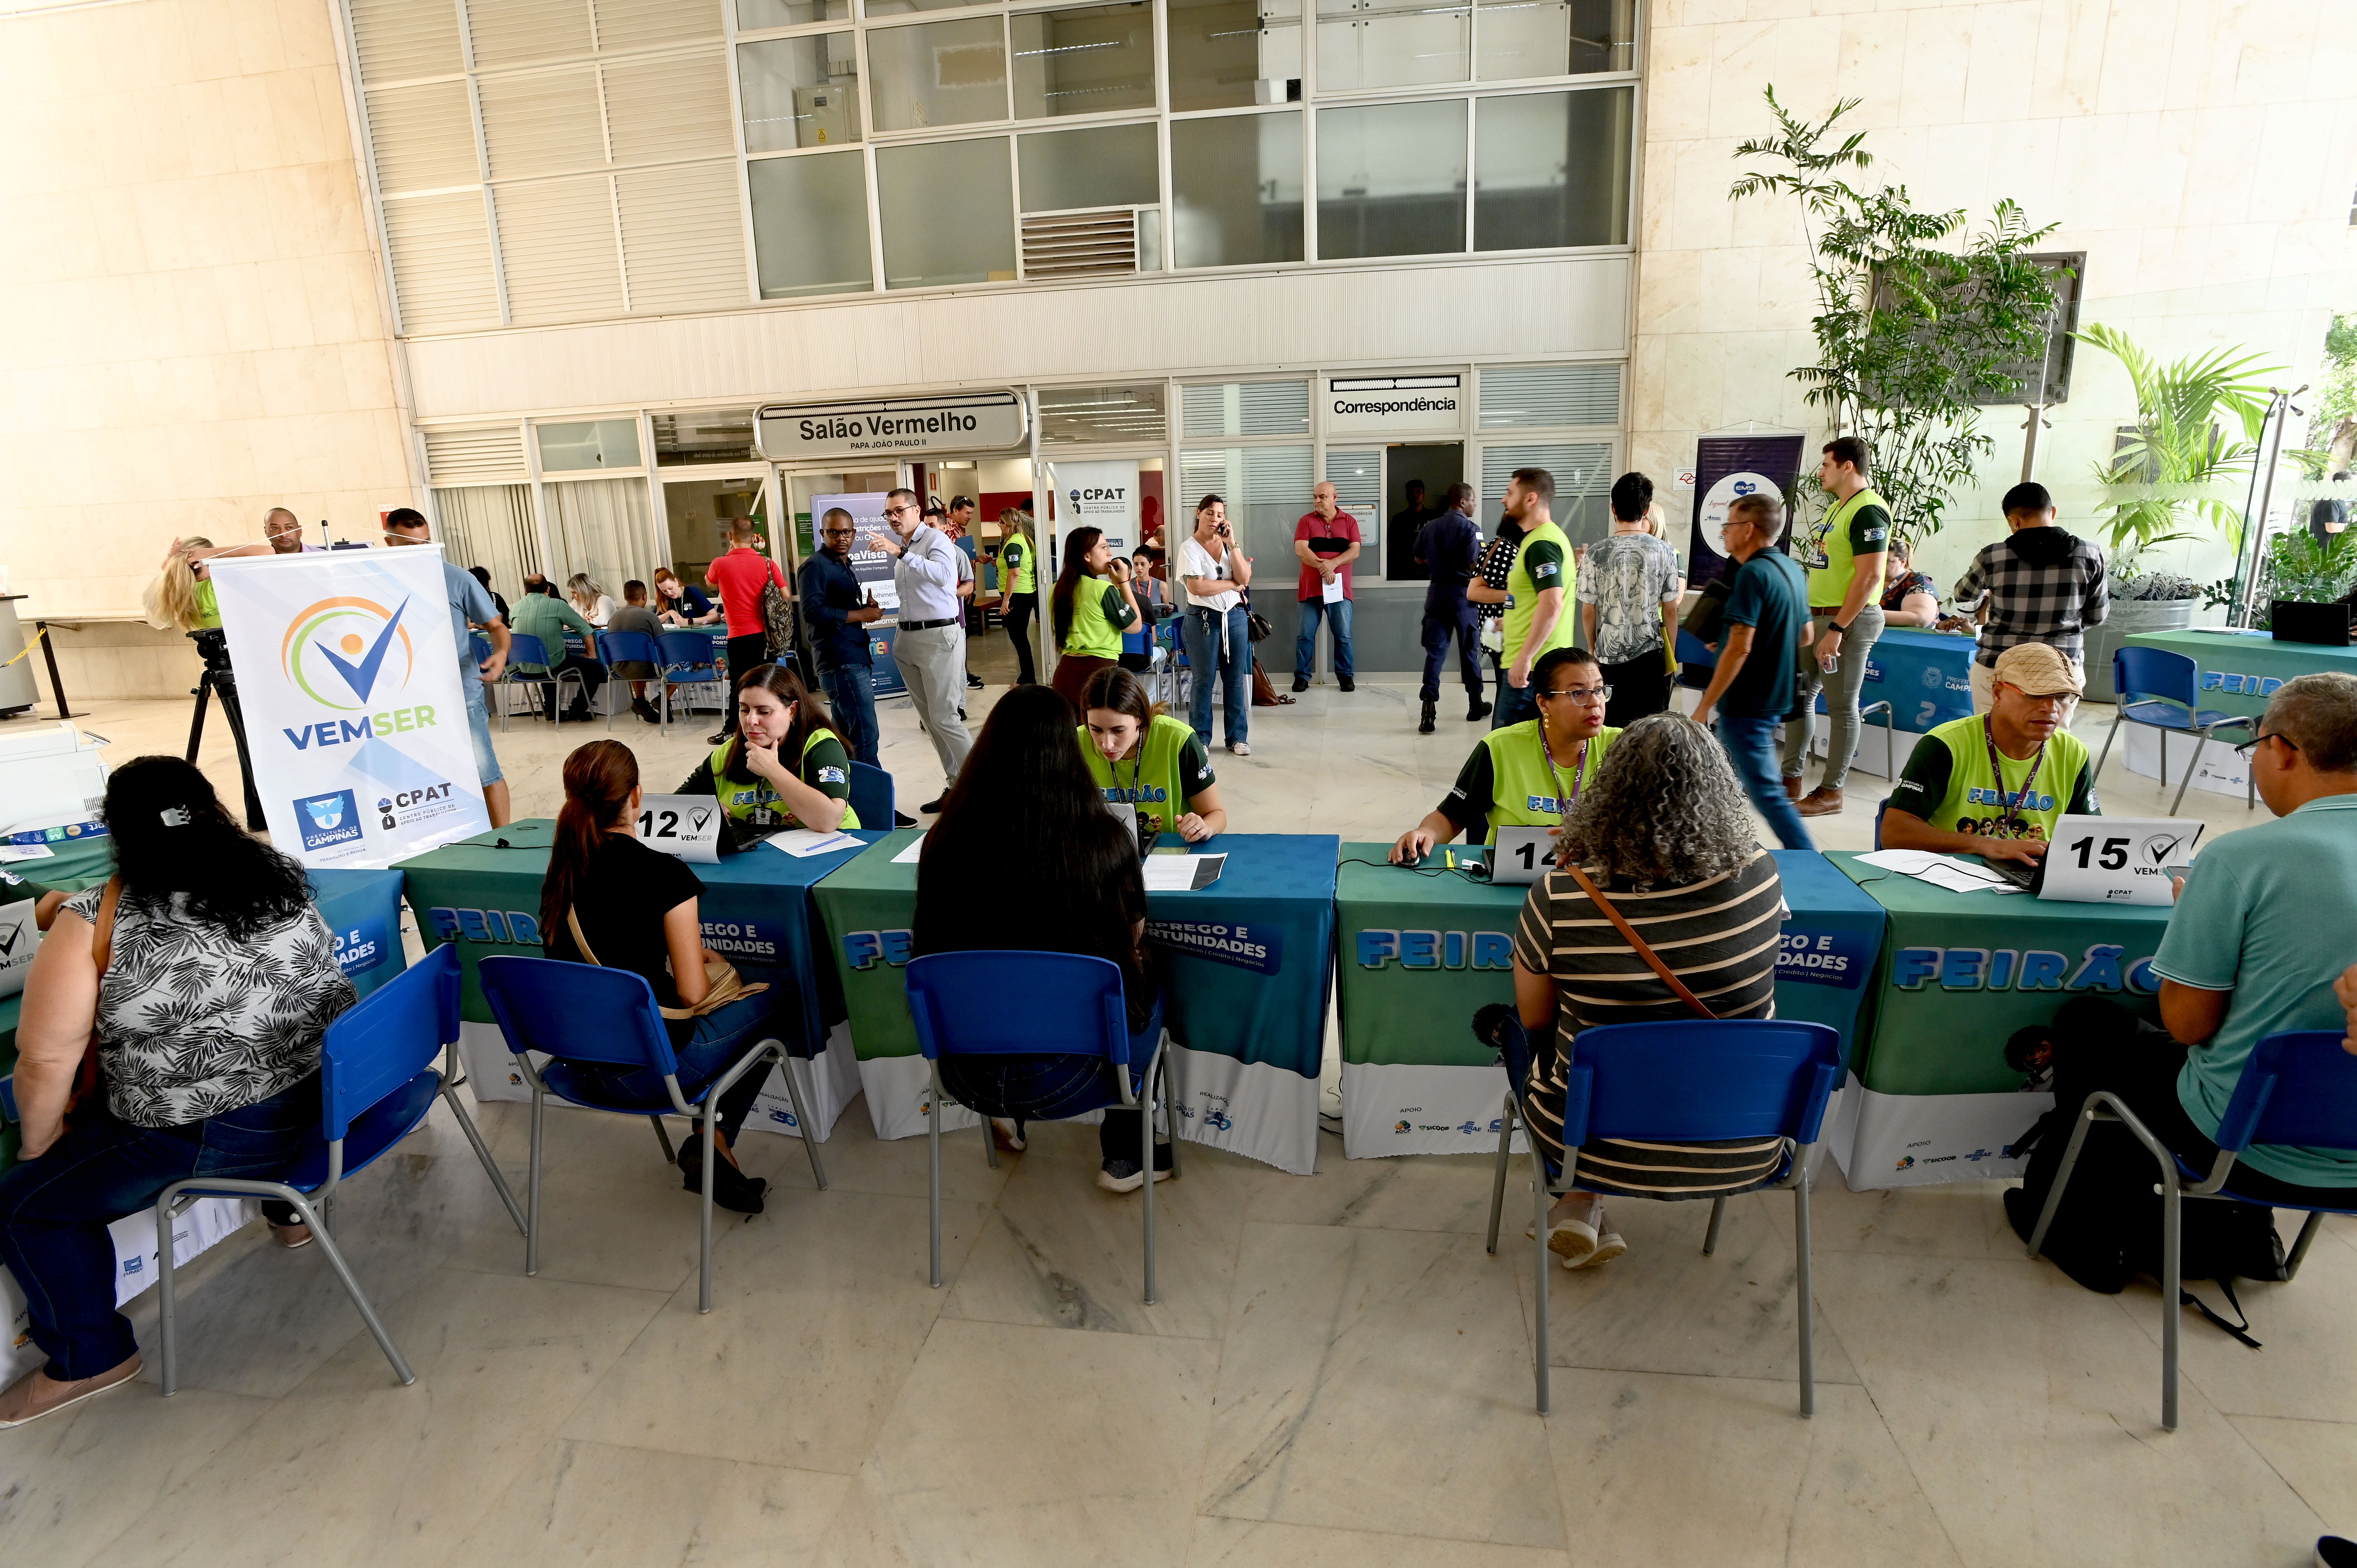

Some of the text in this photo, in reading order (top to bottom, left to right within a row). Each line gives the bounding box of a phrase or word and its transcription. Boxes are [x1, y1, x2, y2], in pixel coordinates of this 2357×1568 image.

[1334, 397, 1456, 415] Correspondência
[800, 411, 977, 441] Salão Vermelho
[850, 441, 869, 450] PAPA
[871, 439, 892, 448] JOÃO
[1083, 488, 1125, 500] CPAT
[847, 550, 887, 560] oaVista
[1945, 682, 1972, 692] CAMPI
[2201, 671, 2284, 697] FEIR
[283, 705, 437, 750] VEMSER
[396, 782, 451, 807] CPAT
[1100, 784, 1166, 803] EIRÃO
[399, 812, 421, 821] CENTRO
[423, 806, 446, 815] PÚBLICO
[639, 810, 678, 837] 12
[49, 832, 62, 841] A4
[306, 828, 345, 840] PREFEITURA
[307, 830, 359, 847] CAMPINAS
[319, 853, 346, 863] TRABALHO
[2070, 836, 2131, 870] 15
[428, 906, 543, 945] FEIR
[699, 923, 756, 938] REGO E
[1147, 922, 1247, 939] PREGO E
[350, 929, 360, 945] E
[1148, 928, 1266, 958] RTUNIDADES
[1816, 936, 1833, 950] E
[1357, 929, 1515, 970] FEIR
[1208, 950, 1231, 959] Crédito
[1236, 957, 1264, 968] Negócios
[758, 1092, 789, 1103] REALIZAÇÃO
[123, 1265, 144, 1277] FUMEC
